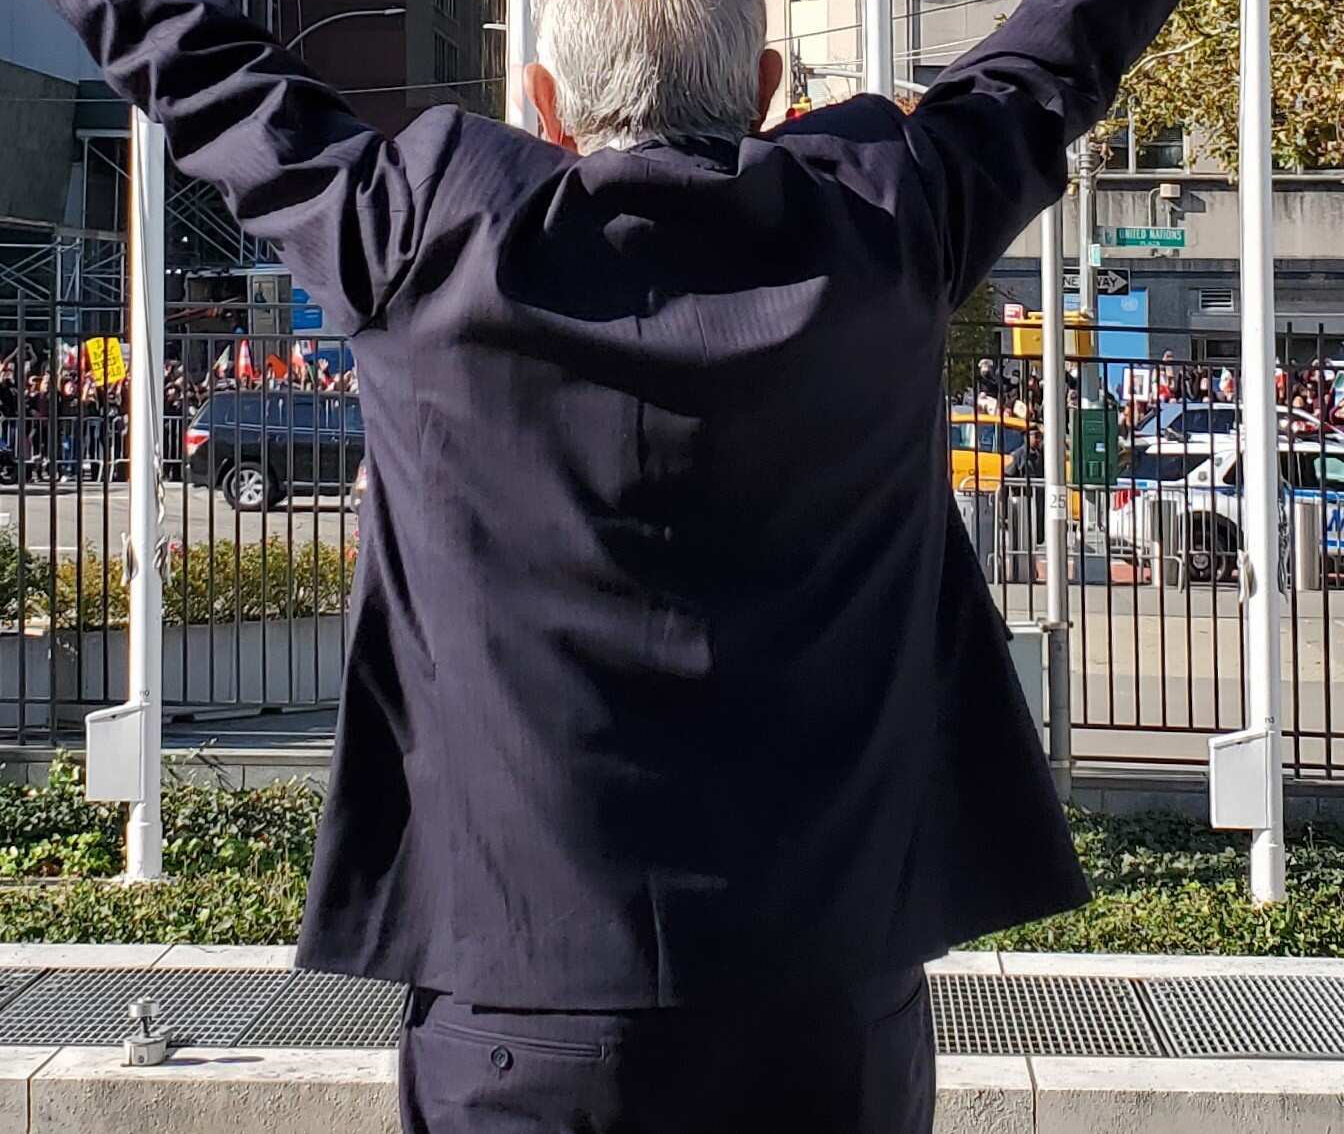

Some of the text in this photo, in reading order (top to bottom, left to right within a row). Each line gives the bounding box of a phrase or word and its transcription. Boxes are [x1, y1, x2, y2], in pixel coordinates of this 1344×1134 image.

[1119, 228, 1182, 241] UNITED NATIONS
[1050, 493, 1066, 509] 25
